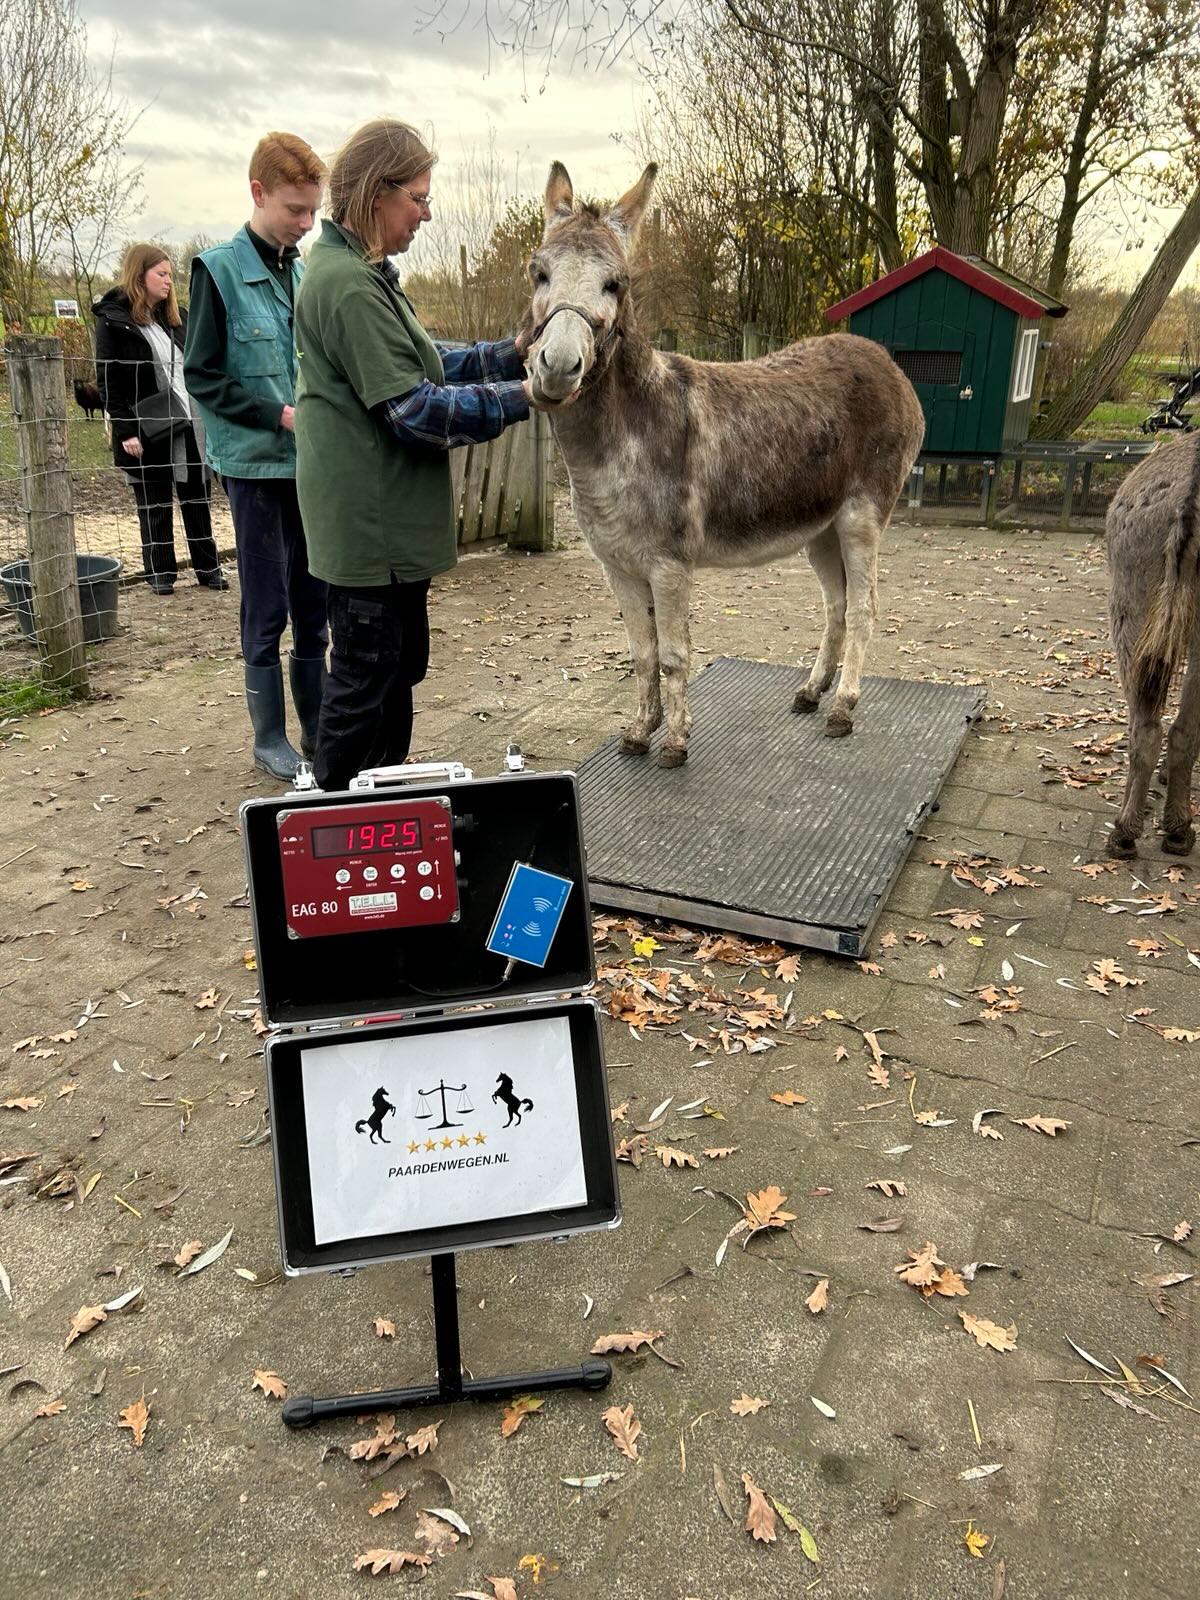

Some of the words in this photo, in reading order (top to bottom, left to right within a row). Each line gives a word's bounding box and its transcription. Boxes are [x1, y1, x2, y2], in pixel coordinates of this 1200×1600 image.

[347, 822, 417, 850] 192.5
[292, 903, 317, 917] EAG
[321, 901, 338, 914] 80
[388, 1152, 510, 1178] PAARDENWEGEN.NL
